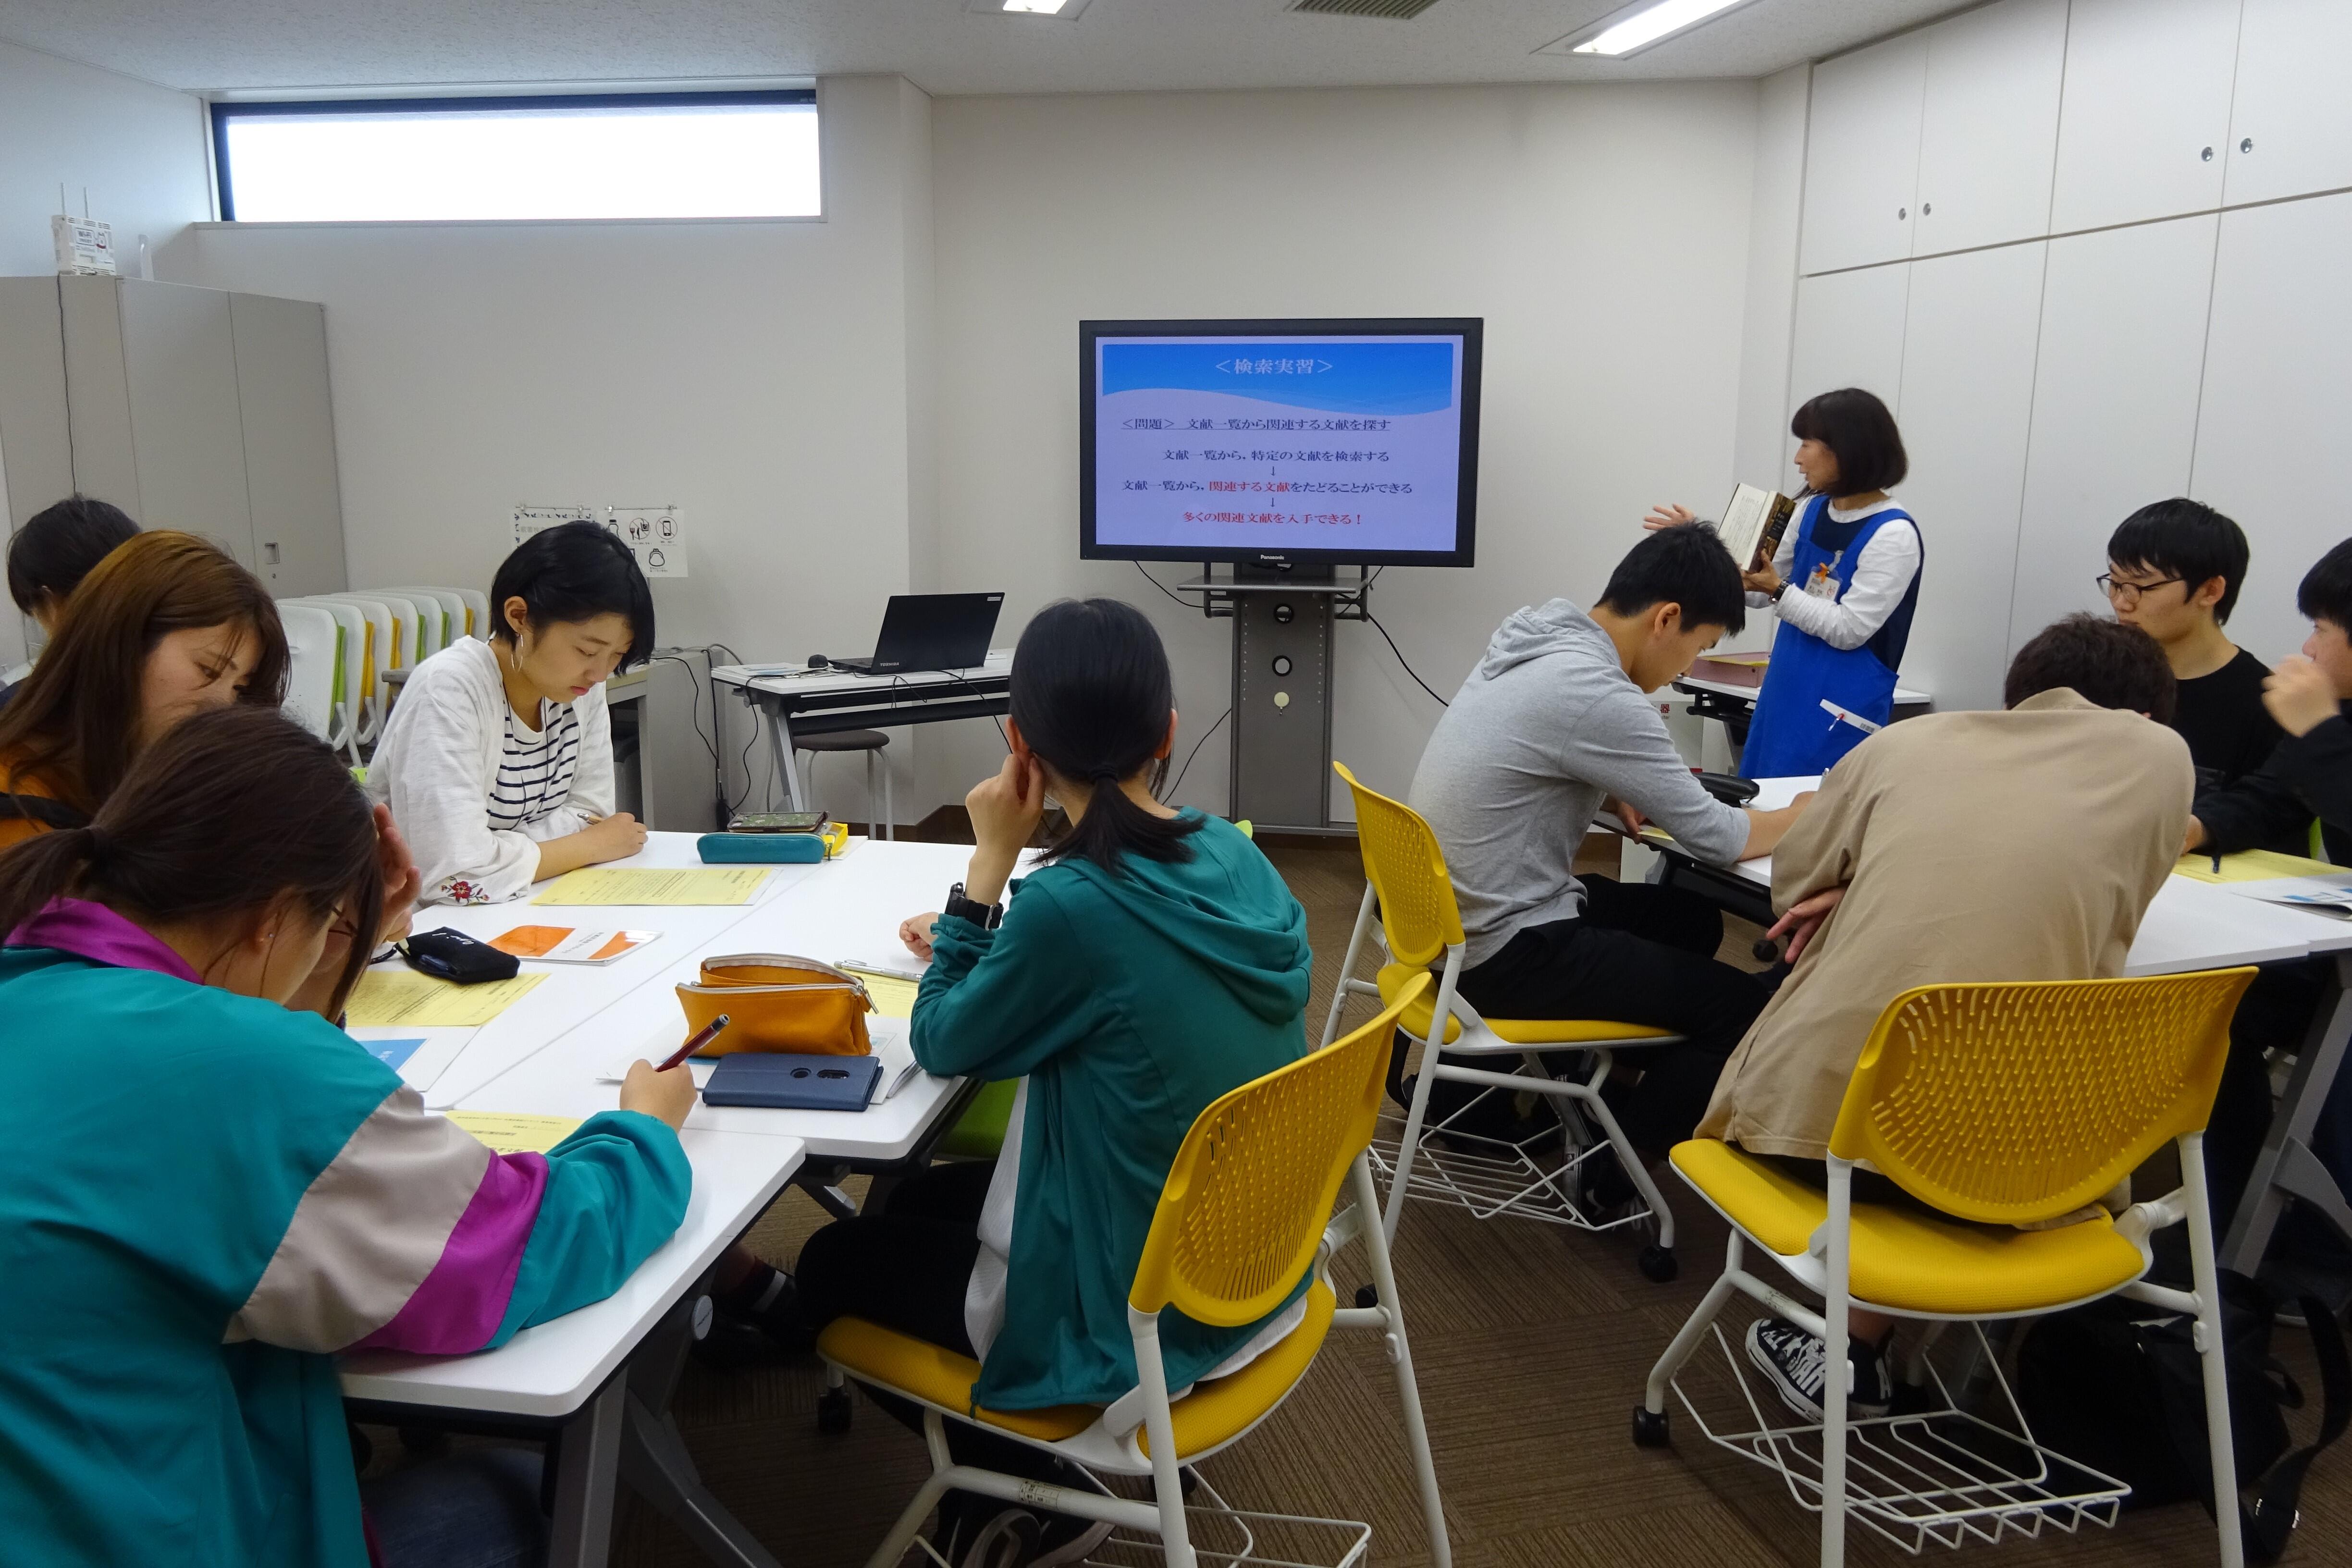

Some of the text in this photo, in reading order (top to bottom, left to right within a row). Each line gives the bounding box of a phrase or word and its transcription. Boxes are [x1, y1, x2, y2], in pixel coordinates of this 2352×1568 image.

[1215, 358, 1333, 375] ＜検索実習＞
[1188, 418, 1391, 430] 文献一覧から関連する文献を探す
